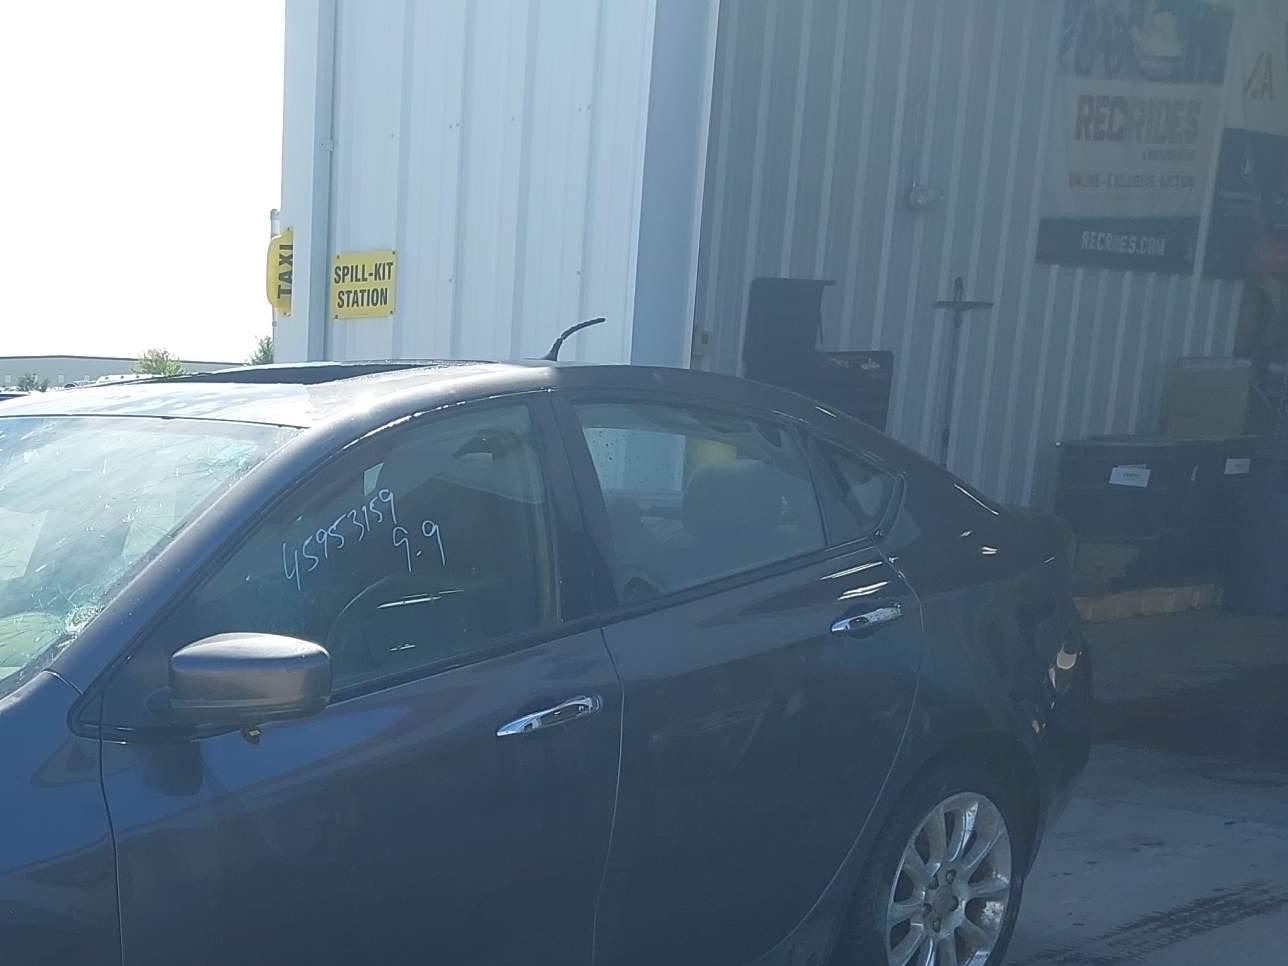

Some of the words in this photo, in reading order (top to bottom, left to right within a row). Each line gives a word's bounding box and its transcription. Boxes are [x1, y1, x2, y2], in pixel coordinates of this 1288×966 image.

[1081, 230, 1165, 257] RECRES.COM
[277, 244, 293, 299] TAXI
[334, 262, 394, 284] SPILL-KIT
[337, 287, 388, 308] STATION
[283, 489, 397, 591] 45953159
[392, 520, 446, 573] 9.9
